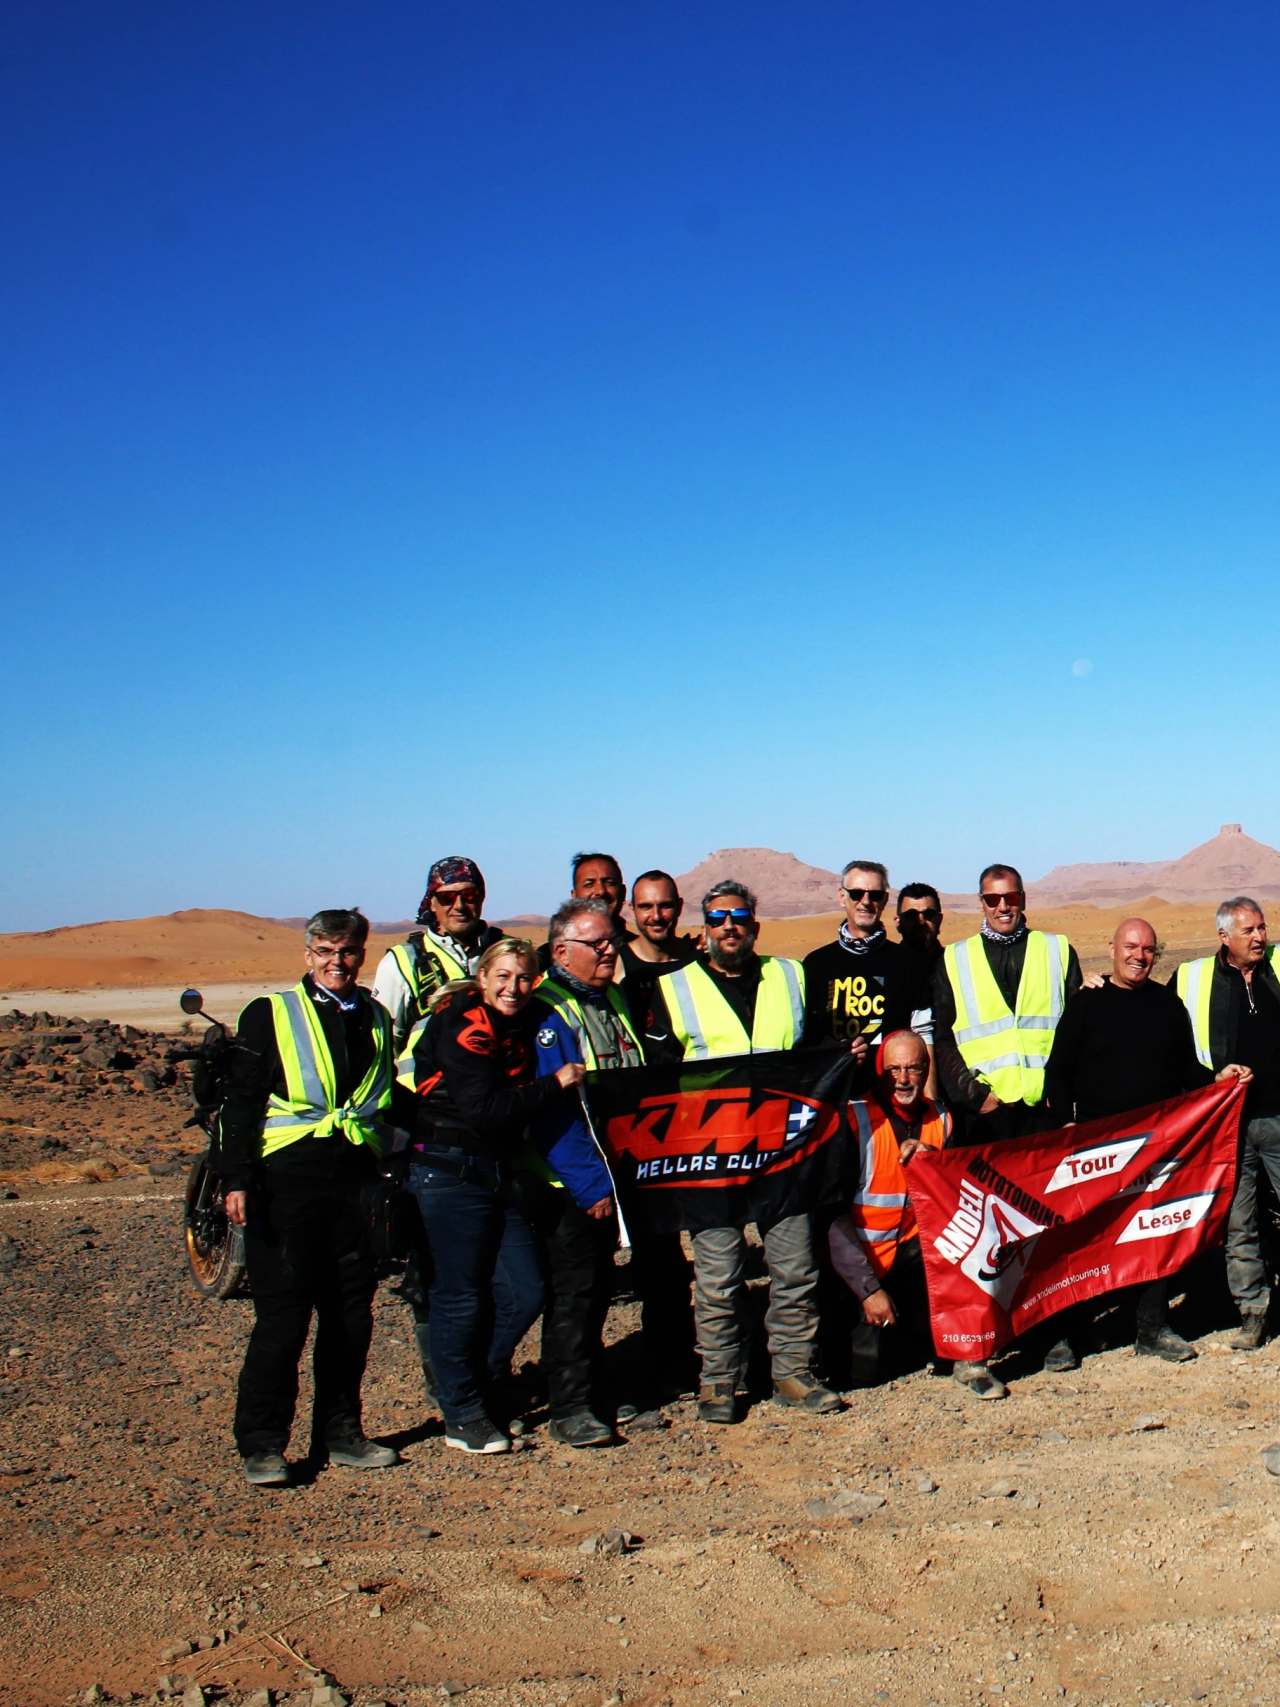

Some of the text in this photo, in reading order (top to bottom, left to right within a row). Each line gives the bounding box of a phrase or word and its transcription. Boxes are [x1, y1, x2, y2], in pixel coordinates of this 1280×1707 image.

[833, 976, 867, 1009] MO
[845, 994, 885, 1017] ROC
[606, 1087, 789, 1162] KTM
[636, 1155, 718, 1180] HELLAS
[1066, 1153, 1118, 1178] Tour
[966, 1158, 1065, 1227] MOTOTOURING
[933, 1178, 985, 1265] ANDELI
[1138, 1208, 1192, 1231] Lease
[942, 1333, 960, 1343] 210
